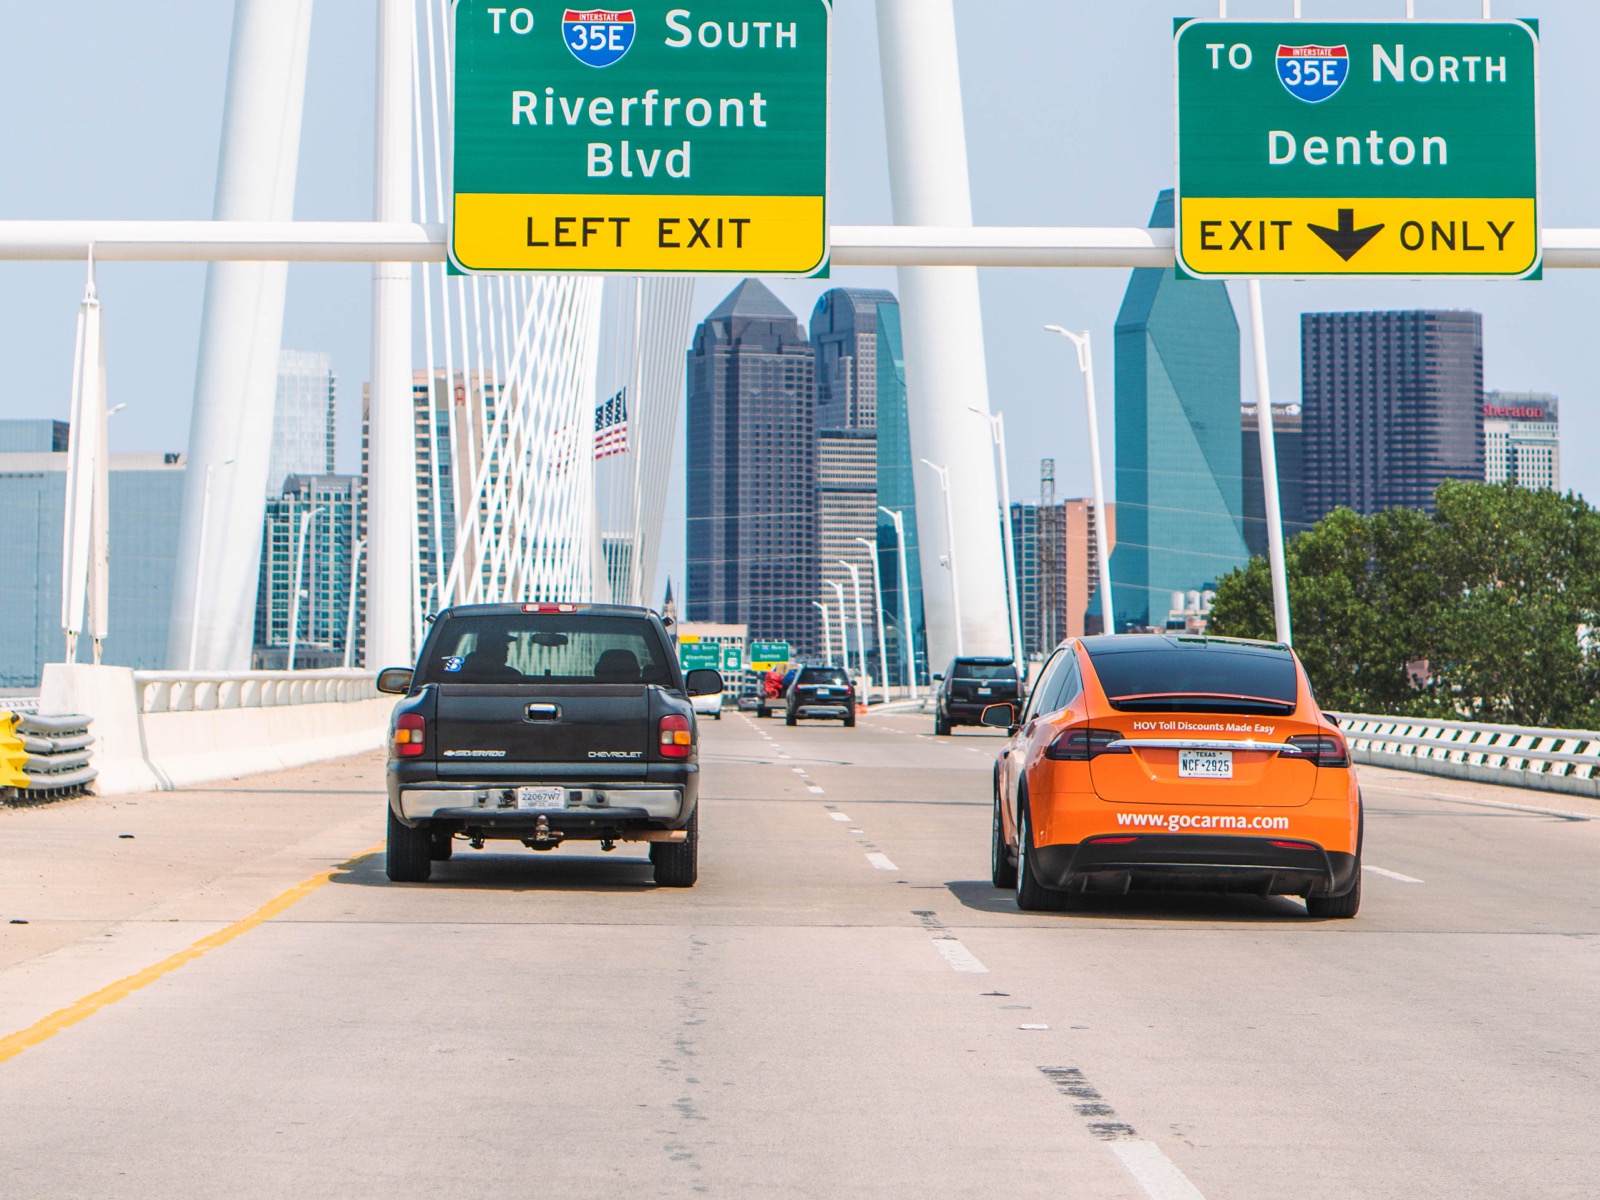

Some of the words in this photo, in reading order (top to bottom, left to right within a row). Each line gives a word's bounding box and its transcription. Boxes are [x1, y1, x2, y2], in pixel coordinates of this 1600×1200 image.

[488, 8, 534, 34] TO
[571, 25, 624, 50] 35E
[665, 9, 797, 48] SOUTH
[579, 13, 619, 21] INTERSTATE
[1206, 43, 1252, 69] TO
[1285, 60, 1338, 85] 35E
[1372, 44, 1507, 82] NORTH
[1292, 48, 1332, 56] INTERSTATE
[511, 87, 768, 127] Riverfront
[587, 141, 691, 178] Blvd
[1268, 130, 1448, 165] Denton
[527, 217, 630, 247] LEFT
[658, 218, 751, 248] EXIT
[1200, 221, 1292, 251] EXIT
[1400, 221, 1515, 251] ONLY
[164, 453, 181, 464] EY
[1133, 721, 1157, 730] HOV
[1158, 721, 1176, 730] Toll
[1177, 722, 1225, 732] Discounts
[1225, 723, 1253, 732] Made
[1254, 724, 1275, 735] Easy
[522, 793, 561, 801] 22067W7
[1117, 813, 1289, 831] www.gocarma.com
